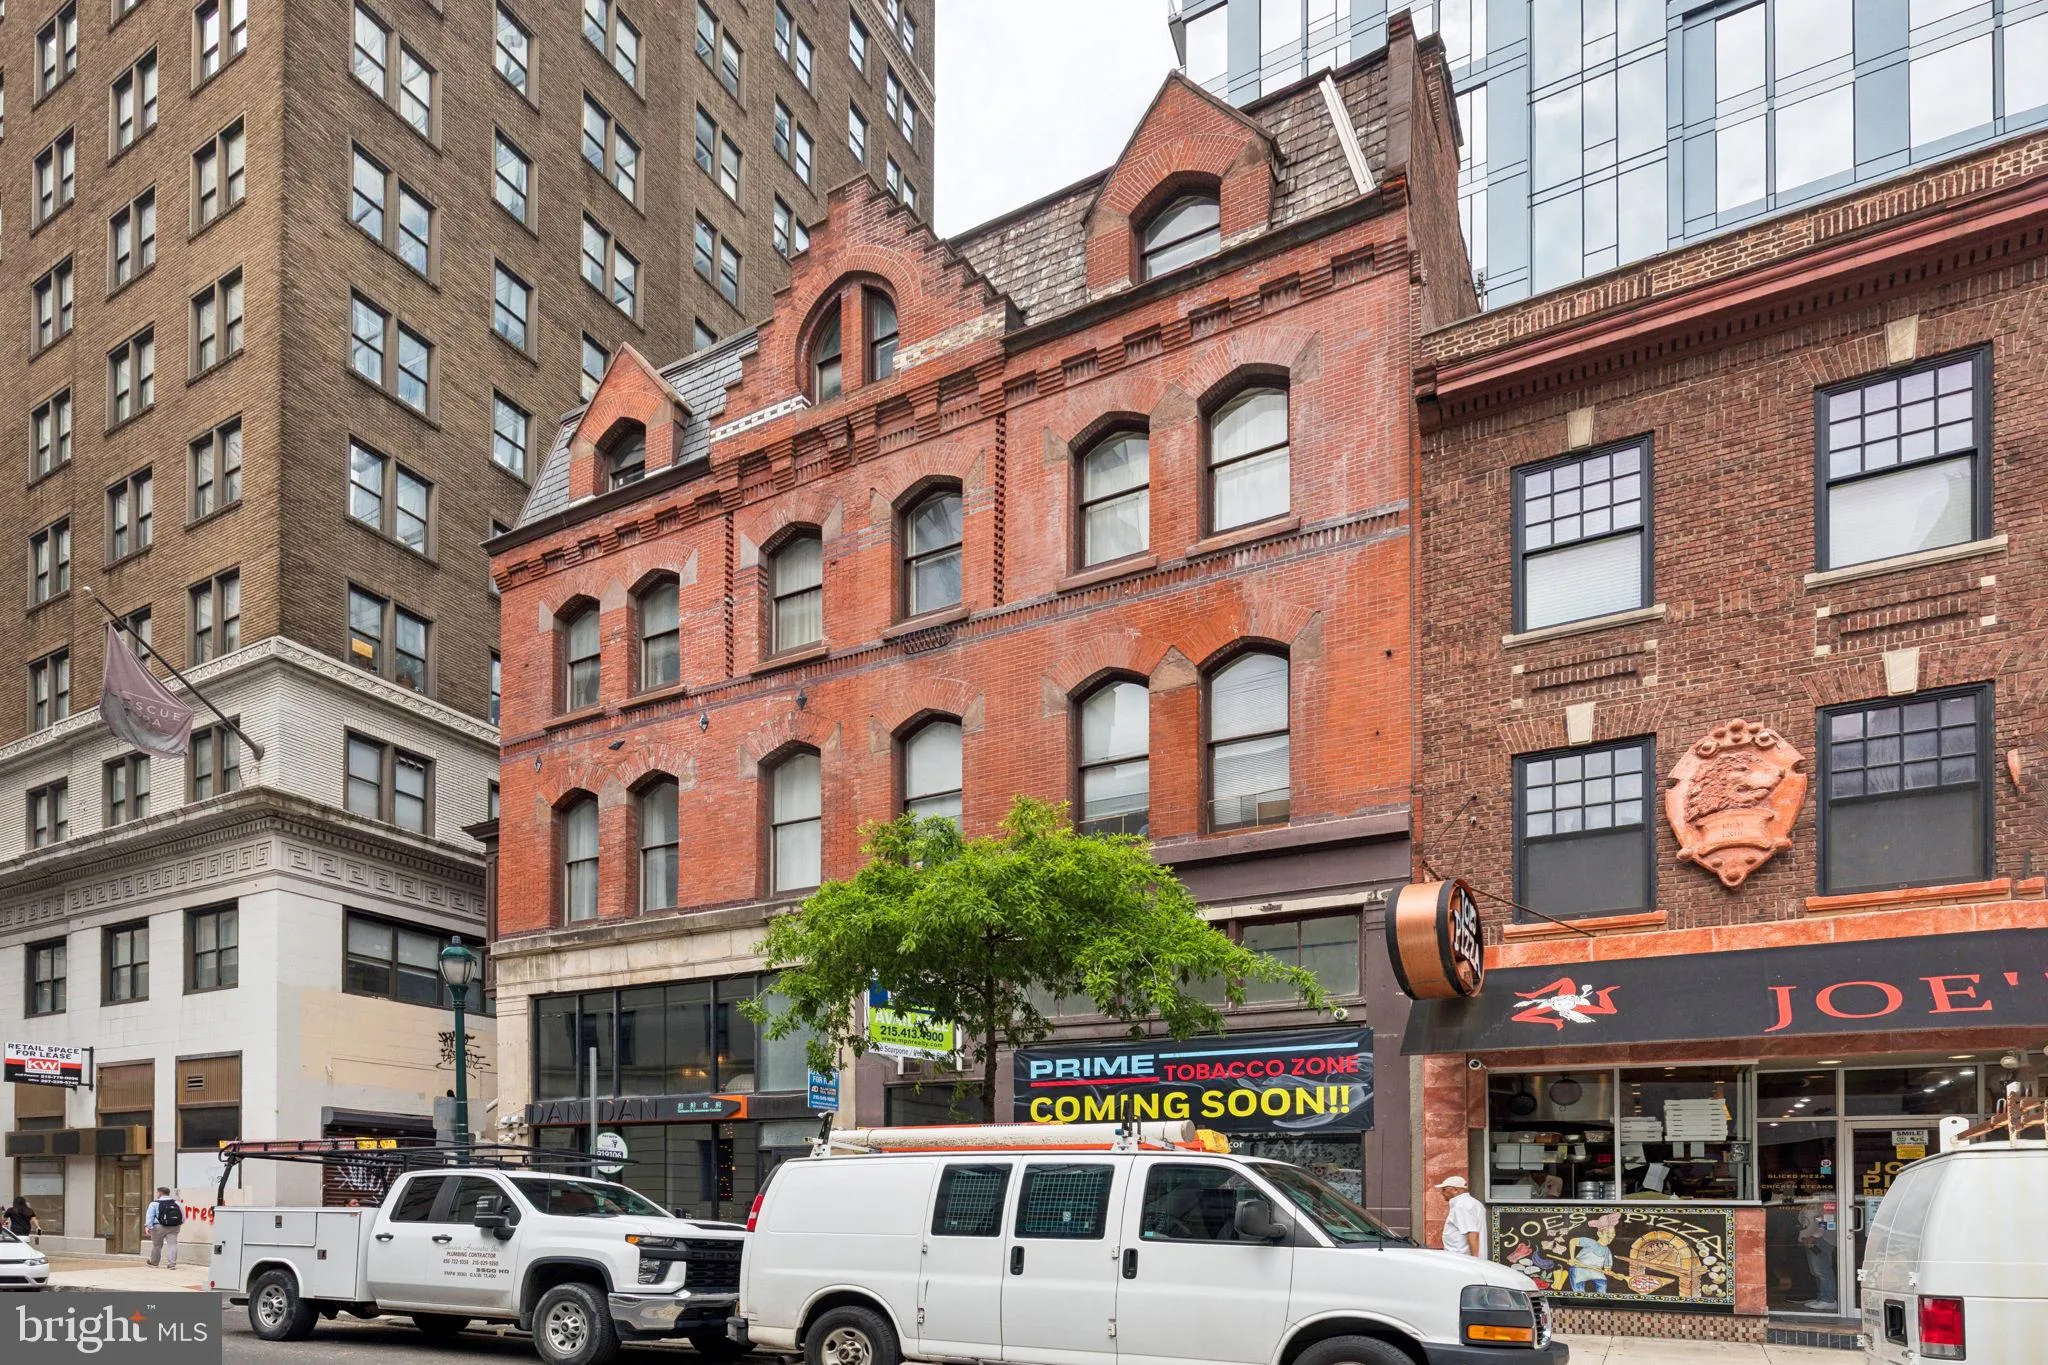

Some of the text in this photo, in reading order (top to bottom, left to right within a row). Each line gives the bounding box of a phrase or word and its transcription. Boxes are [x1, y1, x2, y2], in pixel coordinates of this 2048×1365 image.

[1764, 971, 2048, 1032] JOE'
[880, 1025, 944, 1043] 215.413.4900
[8, 1043, 80, 1055] RETAIL SPACE
[40, 1052, 72, 1060] LEASE
[27, 1060, 58, 1071] KW
[1030, 1054, 1359, 1082] PRIME TOBACCO ZONE
[813, 1075, 823, 1084] FOR
[1030, 1085, 1350, 1123] COMING SOON!!
[530, 1098, 659, 1125] DAN DAN
[1866, 1161, 1905, 1175] JO
[1862, 1174, 1891, 1188] PI
[1499, 1211, 1727, 1261] JOES PIZZA
[690, 1250, 740, 1260] CHEV
